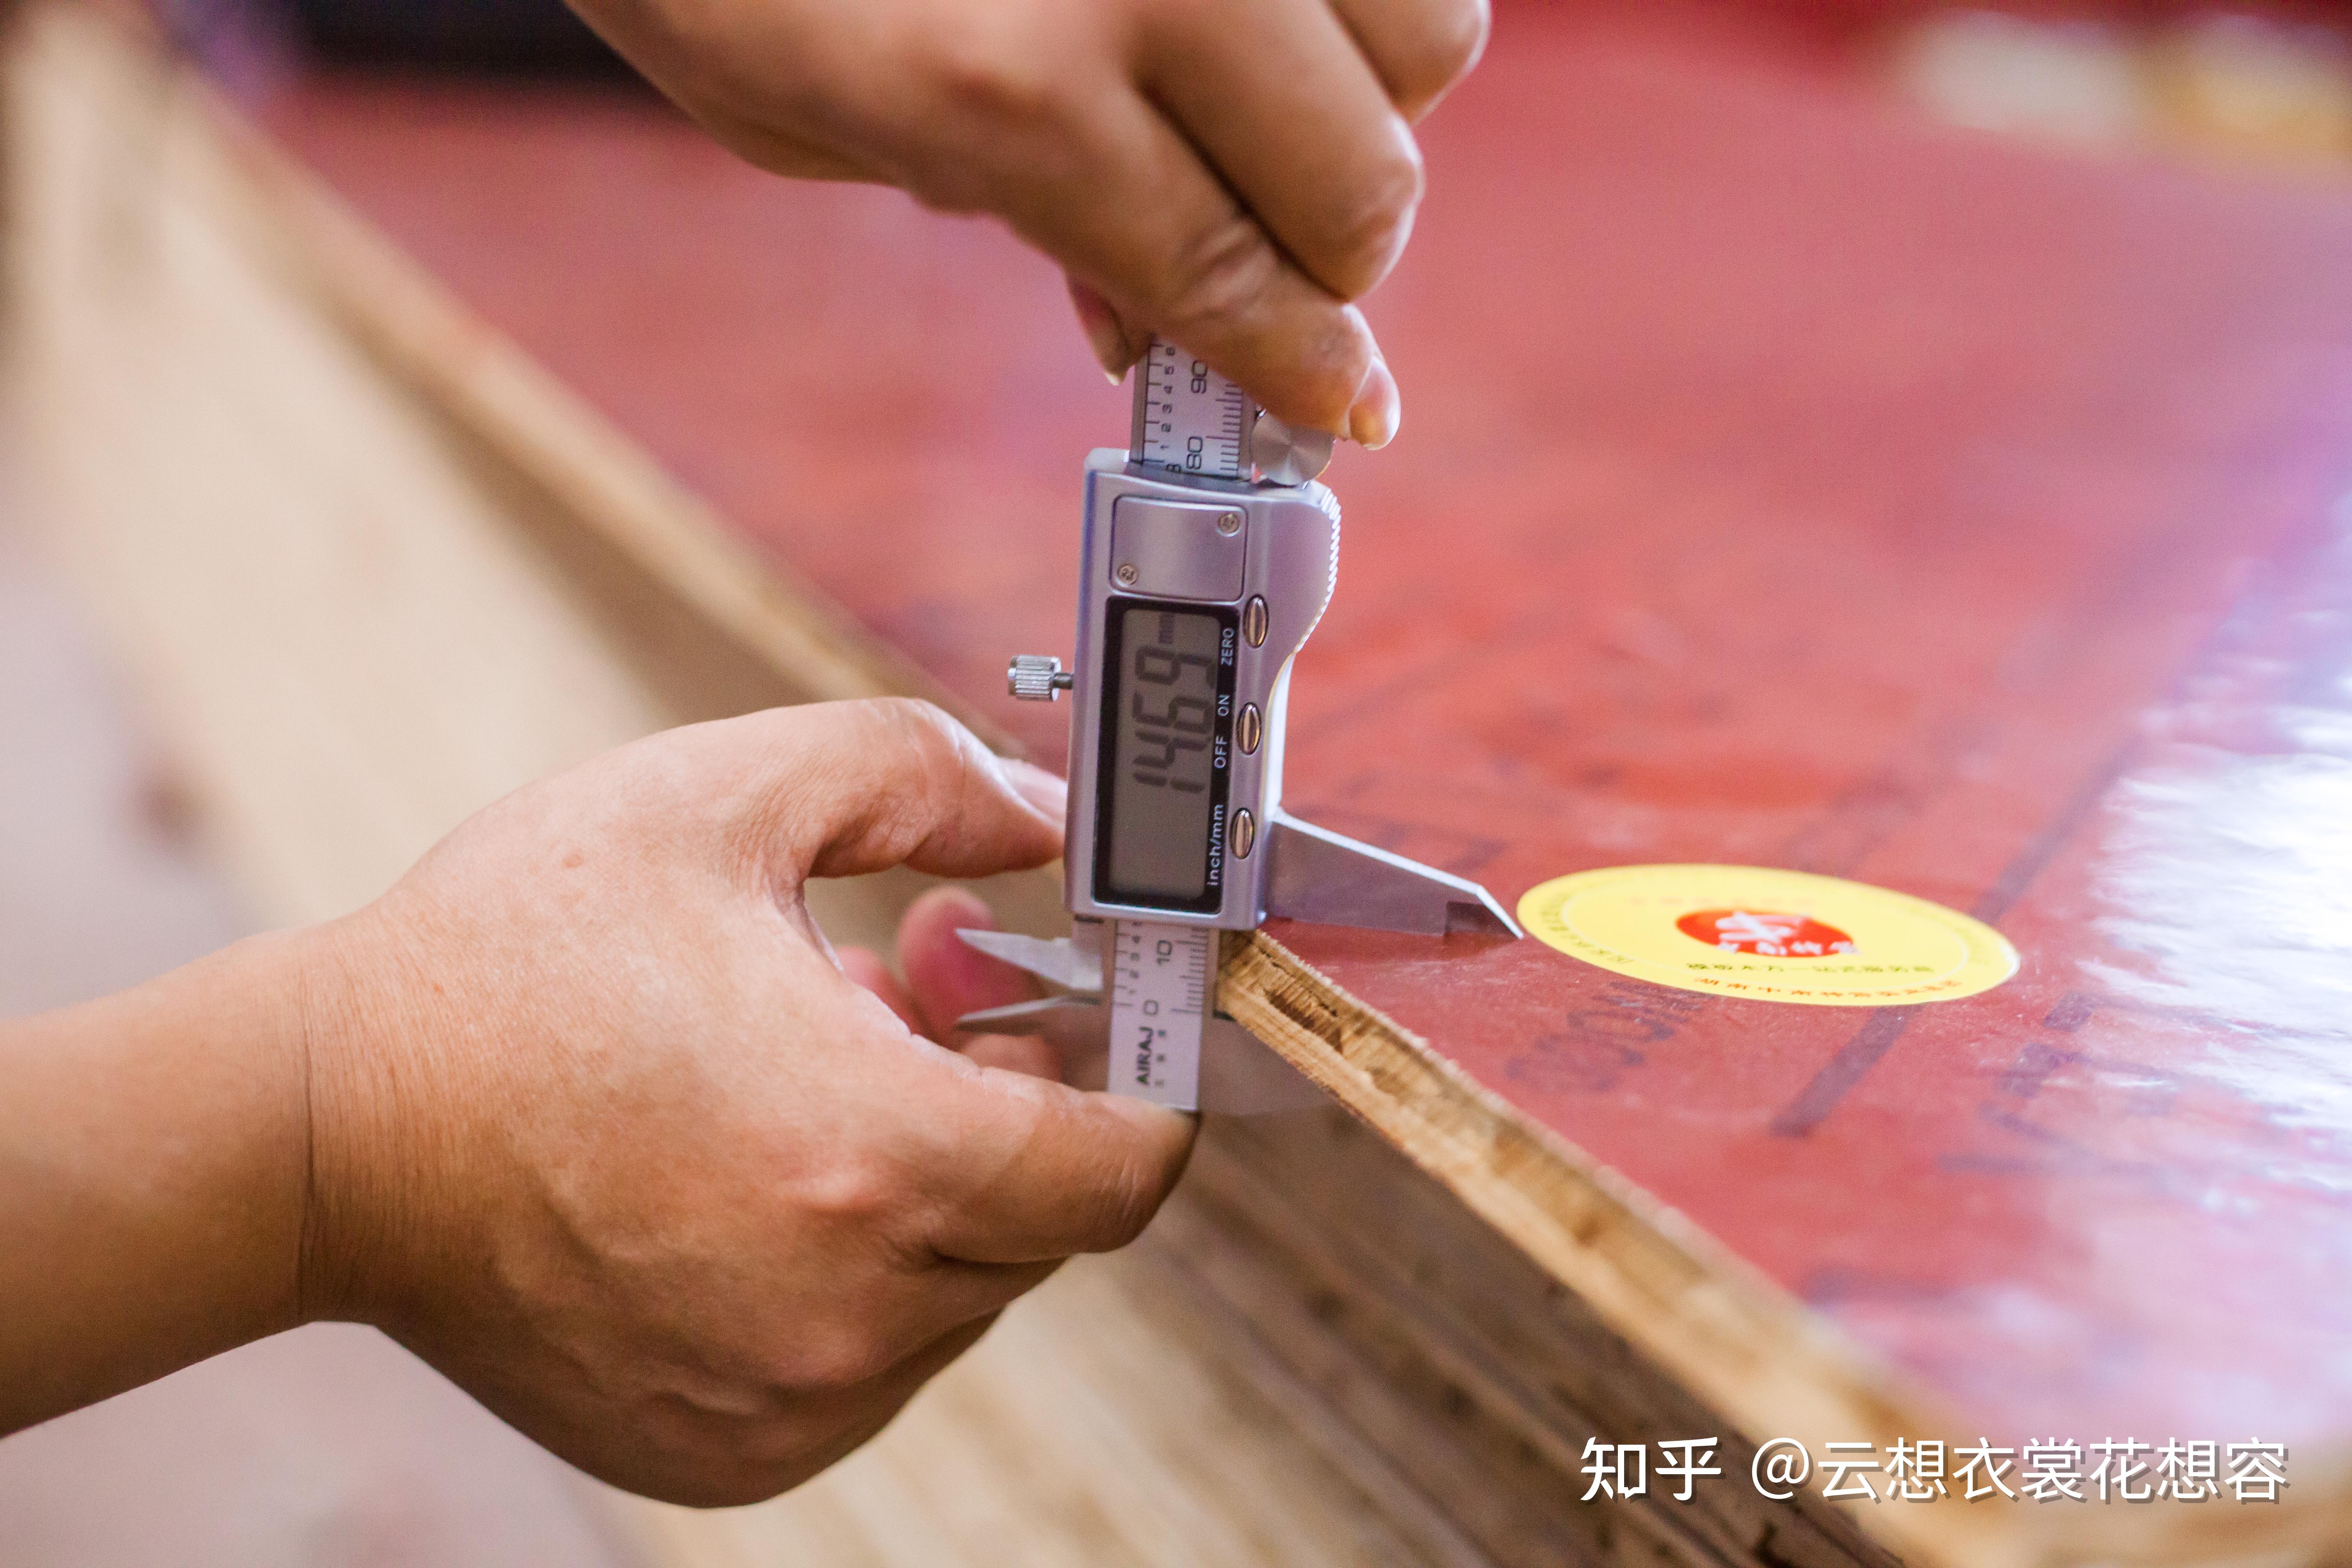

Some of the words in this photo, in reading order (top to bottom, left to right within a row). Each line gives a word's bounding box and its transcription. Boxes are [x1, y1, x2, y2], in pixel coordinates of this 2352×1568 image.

[1191, 360, 1208, 394] 90
[1186, 436, 1203, 469] 80
[1221, 627, 1234, 666] ZERO
[1218, 694, 1230, 717] ON
[1214, 735, 1228, 769] OFF
[1207, 803, 1224, 887] inch/mm
[1143, 999, 1159, 1016] 0
[1156, 939, 1173, 966] 10
